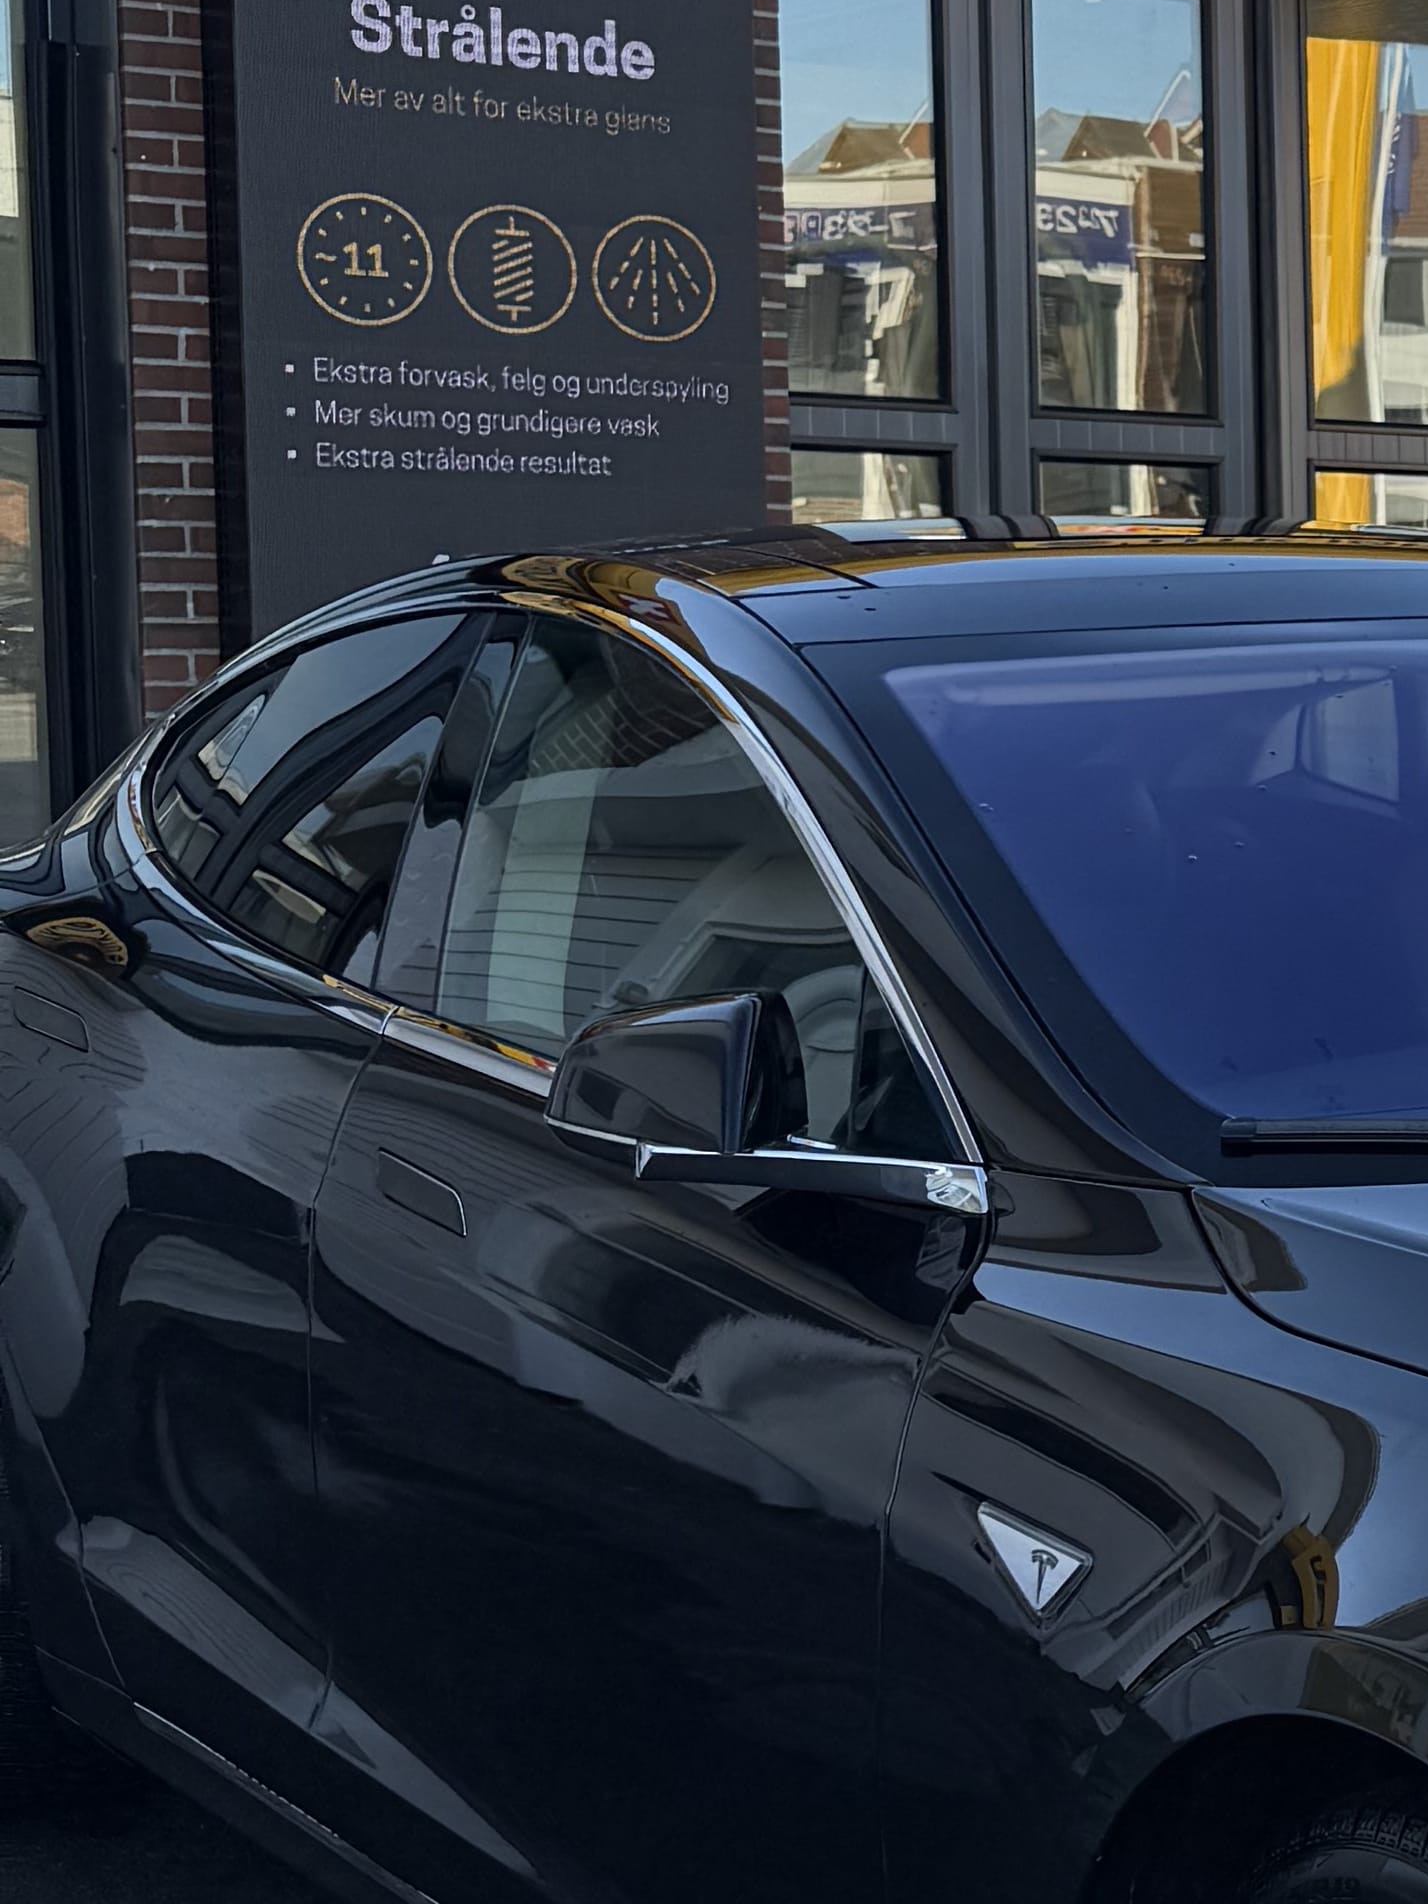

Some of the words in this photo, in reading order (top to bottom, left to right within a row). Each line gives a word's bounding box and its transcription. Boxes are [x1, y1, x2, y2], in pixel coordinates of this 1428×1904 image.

[333, 76, 386, 108] Mer
[394, 89, 425, 112] av
[432, 85, 466, 117] alt
[473, 88, 509, 119] for
[517, 95, 598, 127] ekstra
[606, 104, 672, 136] glans
[313, 356, 393, 385] Ekstra
[398, 360, 497, 393] forvask,
[501, 365, 546, 397] felg
[552, 374, 581, 398] og
[586, 372, 730, 406] underspyling
[315, 399, 363, 426] Mer
[369, 402, 436, 429] skum
[441, 409, 471, 436] og
[477, 408, 602, 439] grundigere
[607, 412, 660, 438] vask
[316, 442, 395, 469] Ekstra
[401, 446, 515, 474] strålende
[520, 450, 613, 477] resultat
